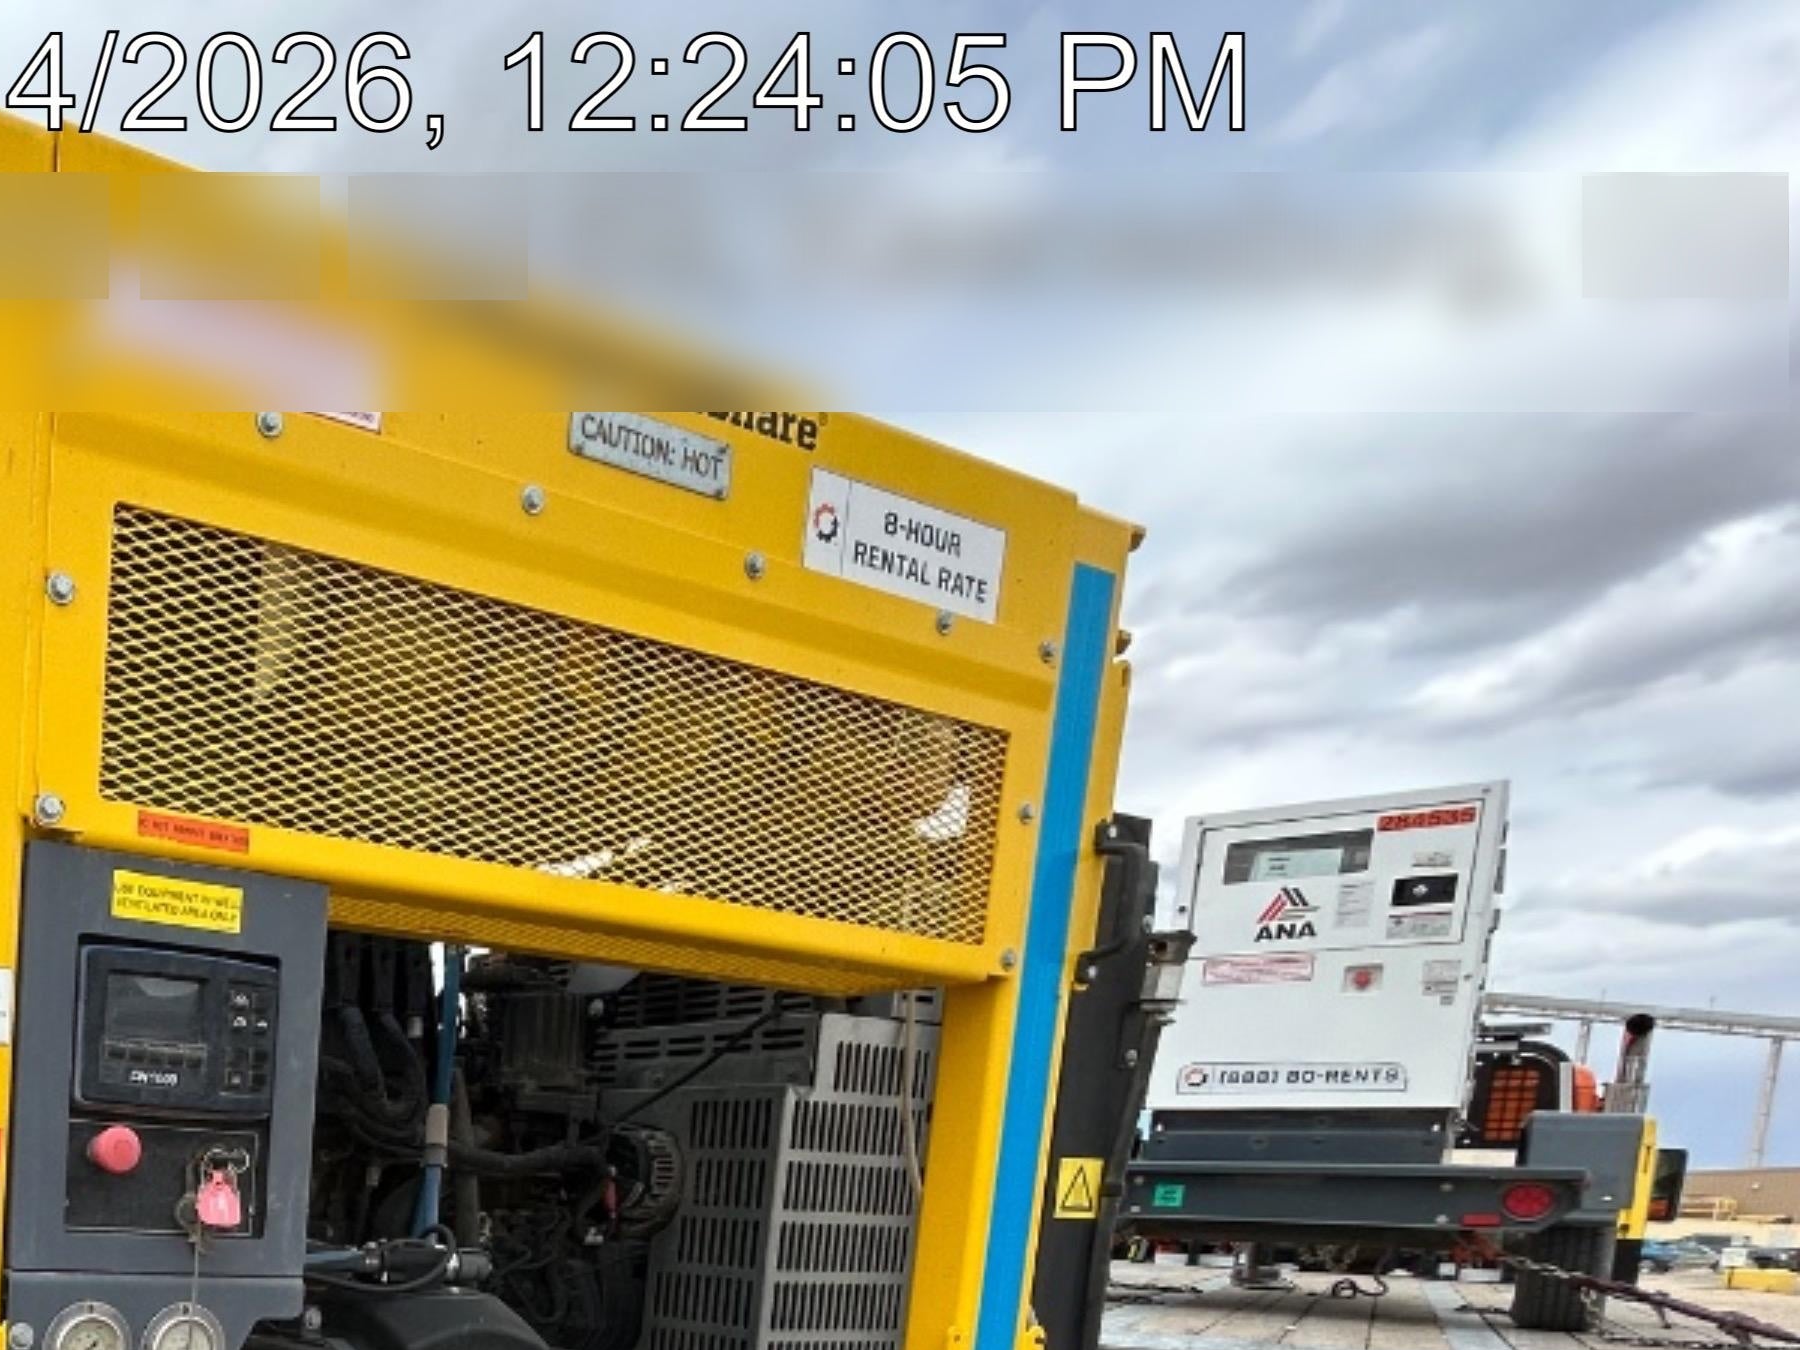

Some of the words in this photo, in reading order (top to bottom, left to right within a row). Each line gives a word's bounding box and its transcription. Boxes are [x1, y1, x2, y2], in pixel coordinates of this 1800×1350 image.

[580, 414, 676, 466] CAUTION:
[681, 446, 724, 481] HOT
[884, 512, 961, 558] 8-HOUR
[853, 540, 931, 586] RENTAL
[937, 567, 988, 603] RATE
[1254, 921, 1317, 943] ANA
